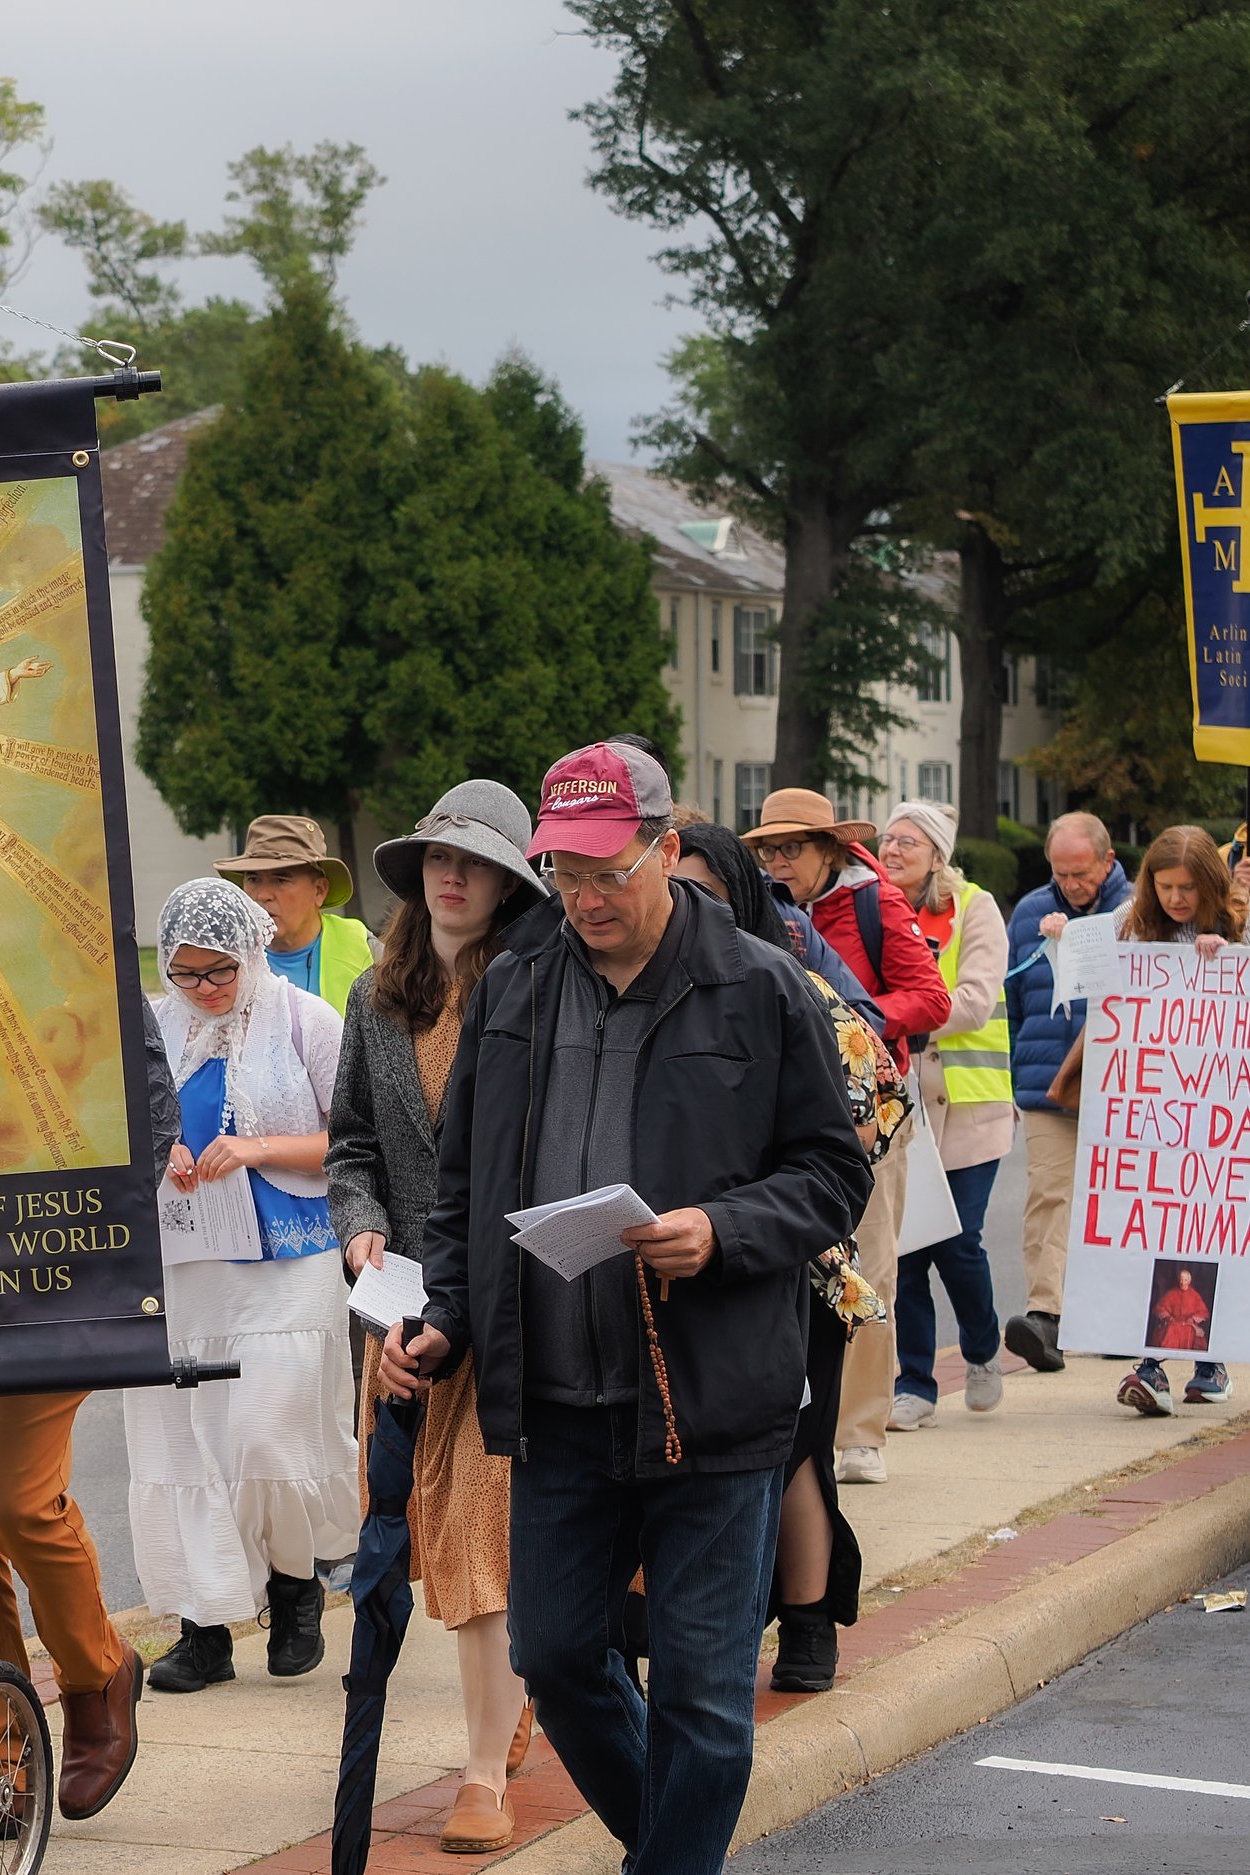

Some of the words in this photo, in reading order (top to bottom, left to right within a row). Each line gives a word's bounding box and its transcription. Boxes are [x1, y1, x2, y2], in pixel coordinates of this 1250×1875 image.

[1212, 465, 1236, 497] A
[1213, 539, 1237, 571] M
[1203, 646, 1242, 664] Latin
[1219, 669, 1248, 688] Soci
[548, 780, 617, 799] JEFFERSON
[1178, 953, 1250, 996] WEEK
[1105, 1097, 1198, 1149] FEAST
[14, 1188, 104, 1227] JESUS
[7, 1224, 131, 1258] WORLD
[30, 1265, 73, 1292] US
